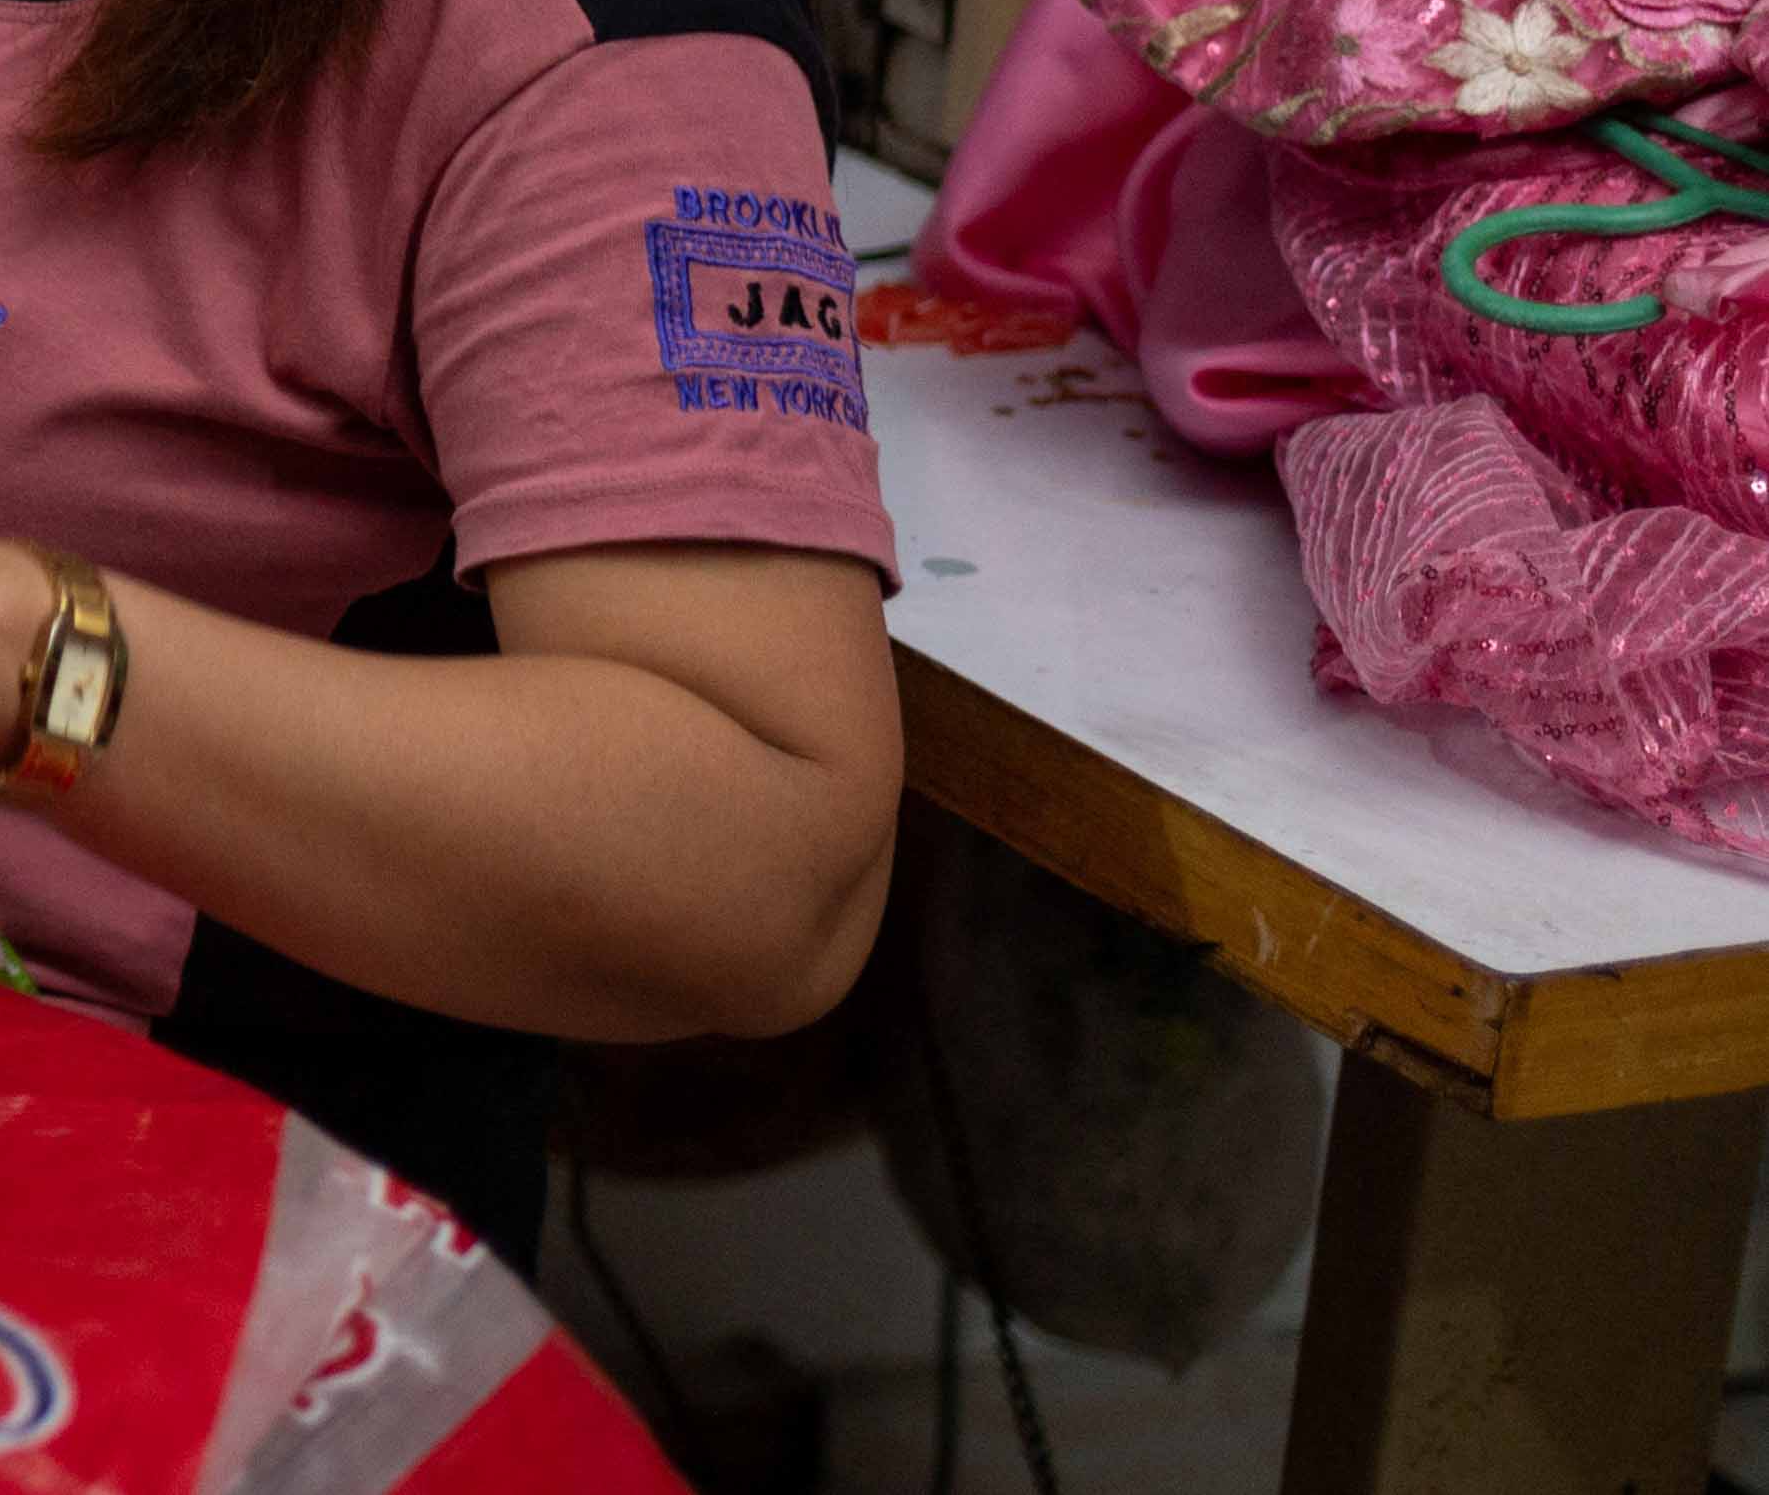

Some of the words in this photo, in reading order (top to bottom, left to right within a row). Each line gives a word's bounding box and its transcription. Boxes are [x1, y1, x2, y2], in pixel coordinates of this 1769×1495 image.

[727, 281, 843, 342] JAG
[674, 373, 760, 412] NEW
[765, 378, 843, 425] YORK
